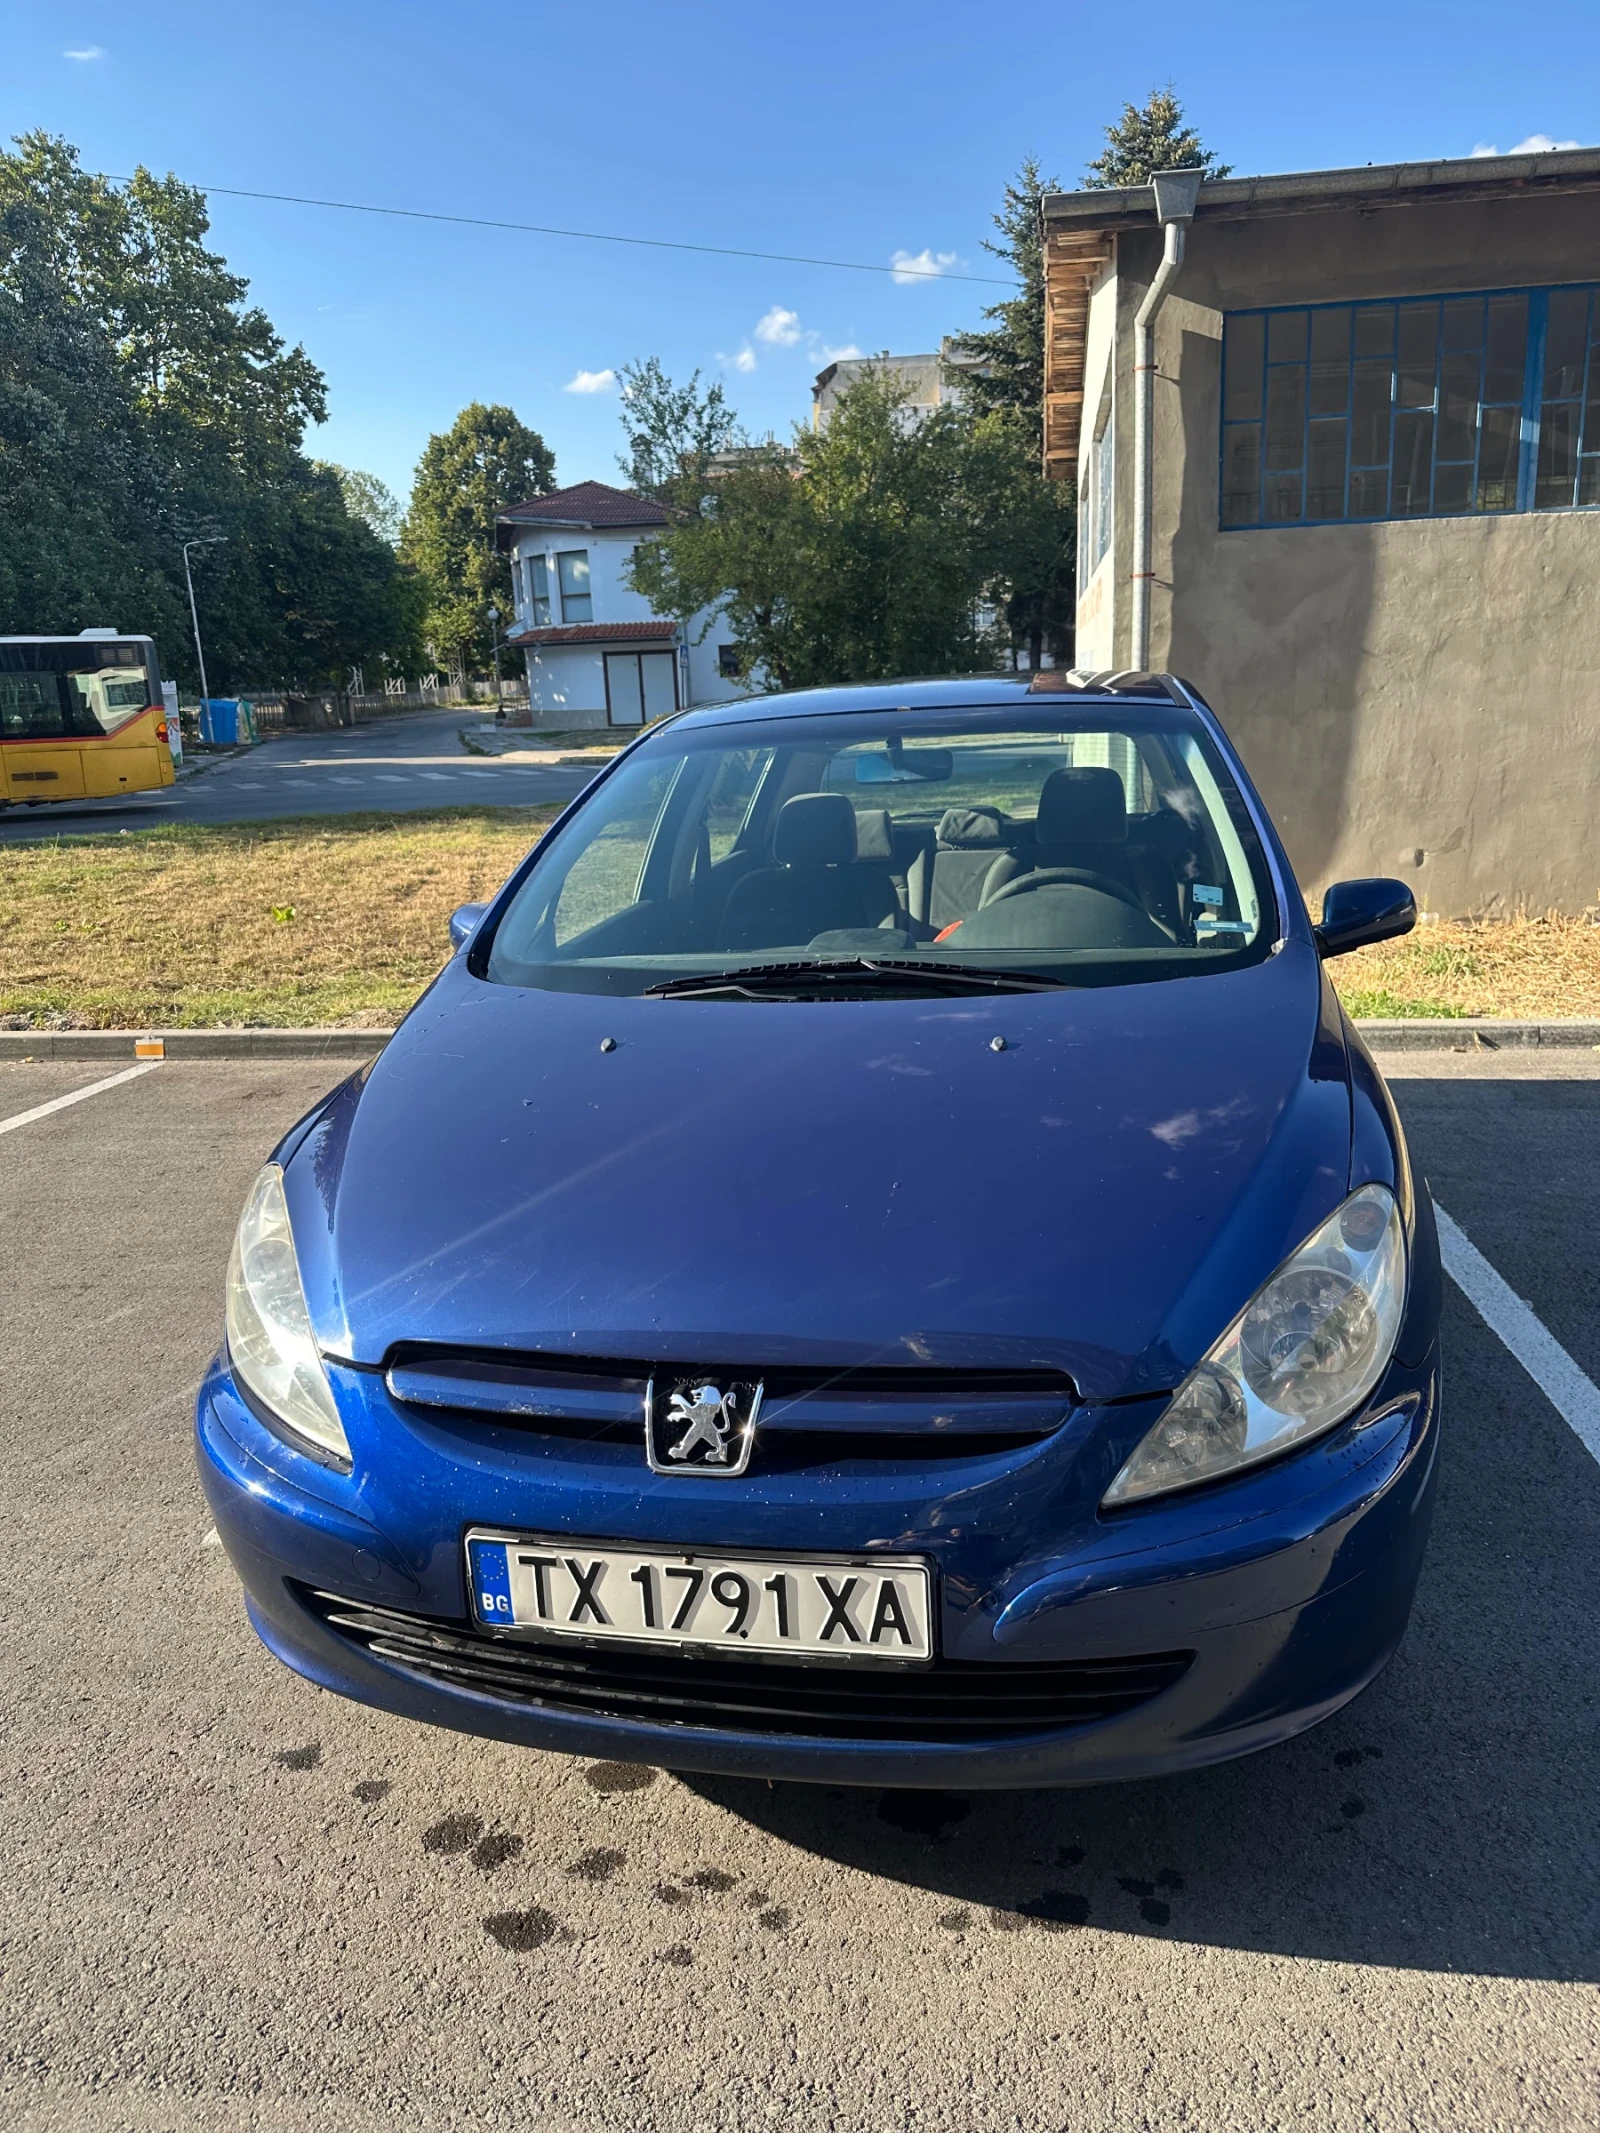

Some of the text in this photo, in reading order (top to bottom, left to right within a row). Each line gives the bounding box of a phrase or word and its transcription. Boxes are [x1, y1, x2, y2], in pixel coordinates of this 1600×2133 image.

[481, 1592, 510, 1613] BG
[517, 1554, 913, 1645] TX 1791 XA
